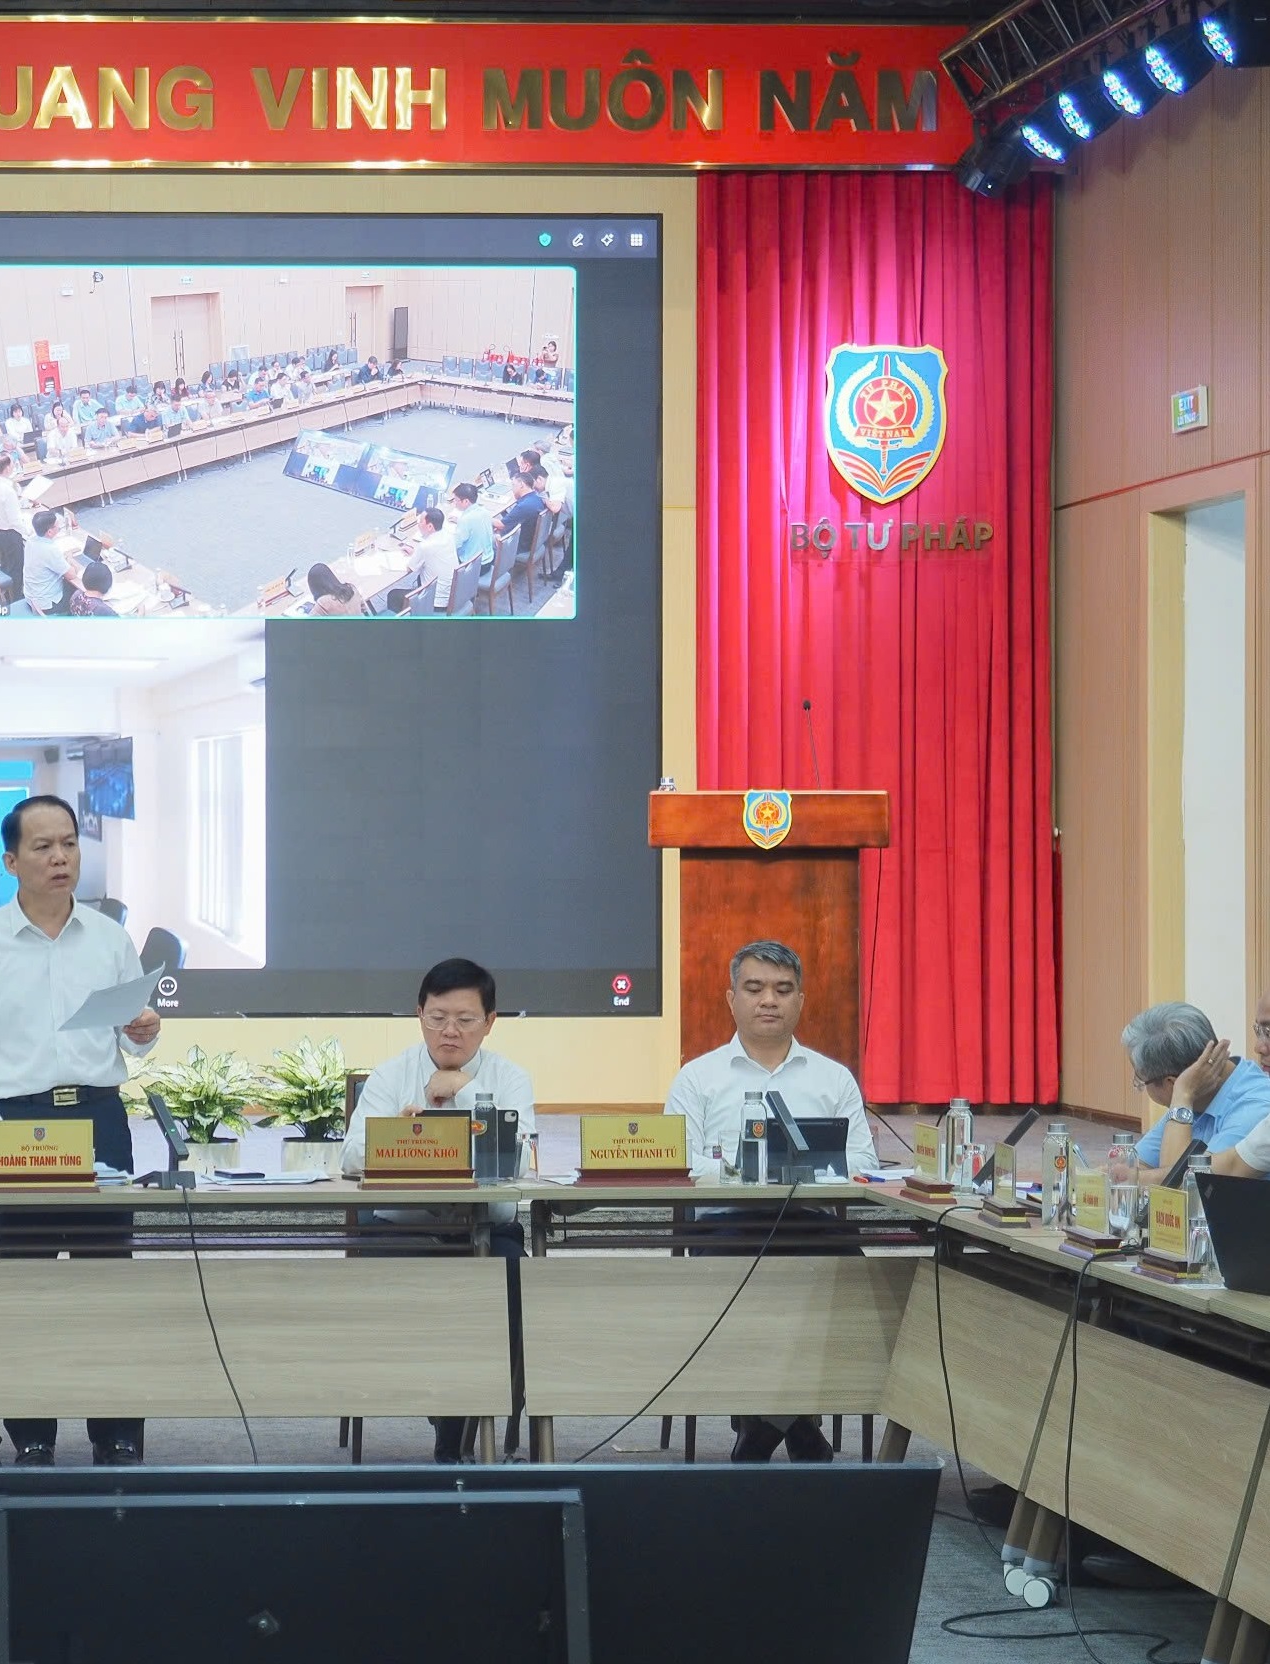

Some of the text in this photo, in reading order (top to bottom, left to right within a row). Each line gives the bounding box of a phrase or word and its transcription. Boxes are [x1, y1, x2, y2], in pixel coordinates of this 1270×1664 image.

[250, 66, 447, 132] VINH
[482, 49, 722, 133] MUÔN
[759, 50, 937, 133] NĂM
[791, 516, 994, 559] BỘ TƯ PHÁP
[157, 997, 179, 1008] More
[613, 996, 630, 1006] End
[376, 1148, 396, 1158] MAI
[630, 1149, 663, 1159] THANH
[665, 1146, 677, 1159] TÚ
[29, 1156, 58, 1167] THANH
